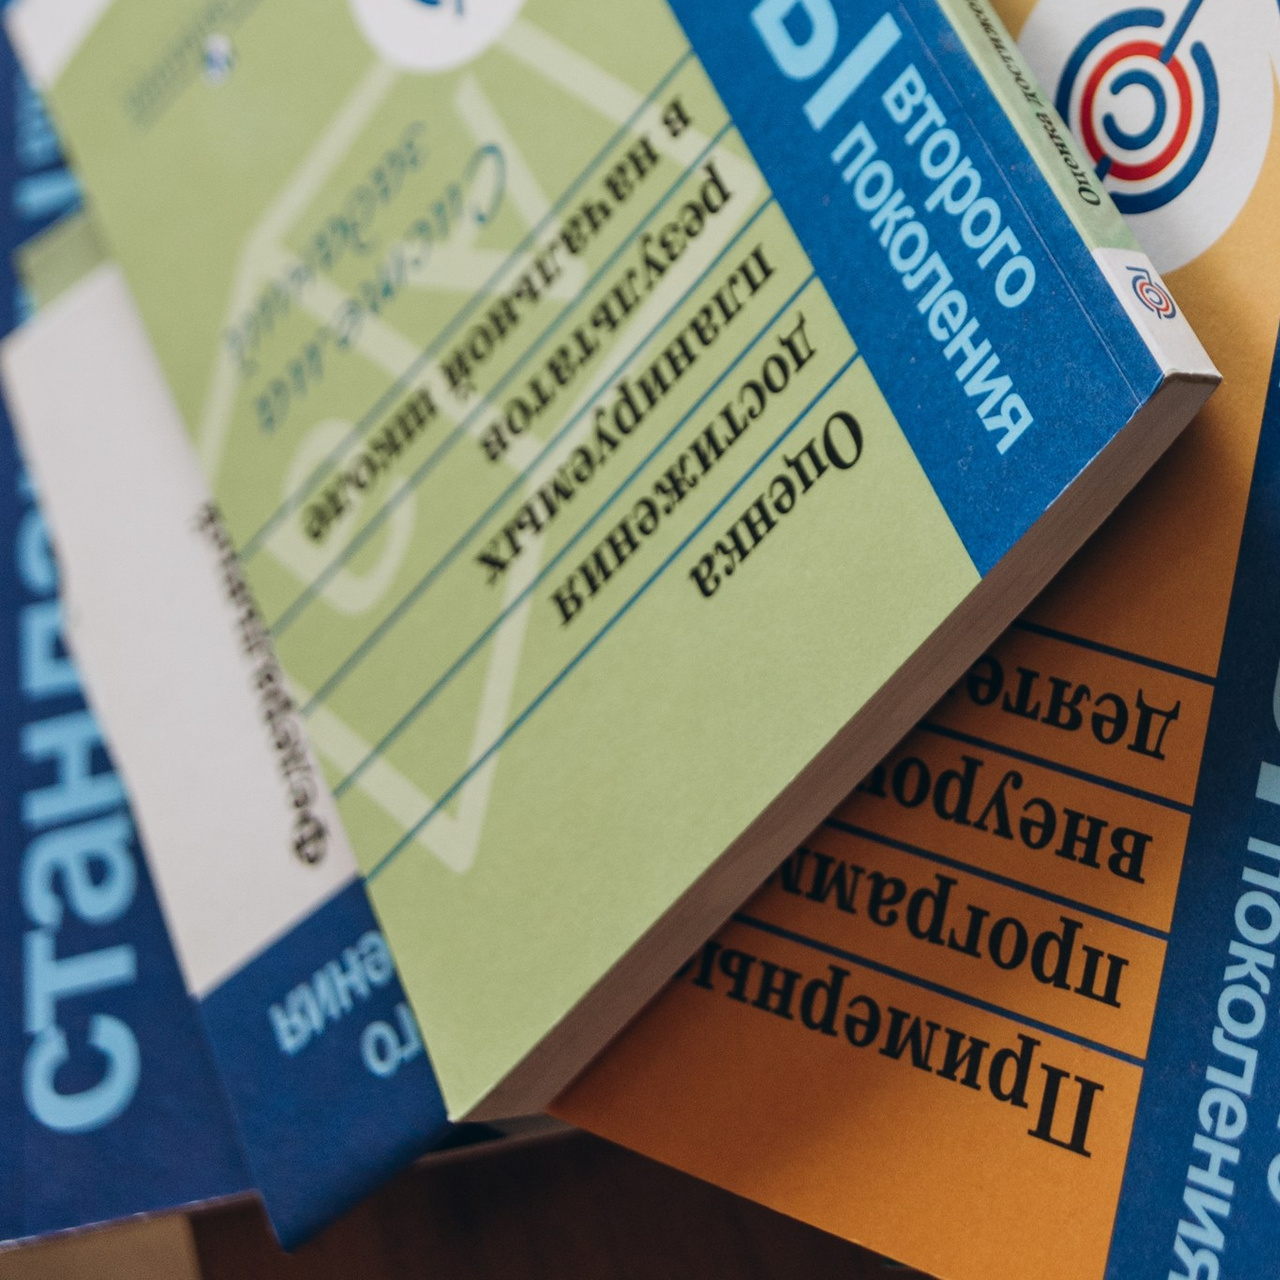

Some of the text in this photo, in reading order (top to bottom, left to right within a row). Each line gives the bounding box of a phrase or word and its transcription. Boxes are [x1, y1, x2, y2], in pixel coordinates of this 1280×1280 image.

[830, 120, 1035, 456] поколения
[882, 62, 1038, 309] второго
[1037, 109, 1101, 207] Оценка
[300, 95, 693, 545] в начальной школе
[473, 242, 780, 587] планируемых
[477, 158, 734, 465] результатов
[548, 310, 819, 627] достижения
[685, 410, 865, 600] Оценка
[858, 754, 1154, 885] внеуро
[675, 940, 1105, 1159] Примерны
